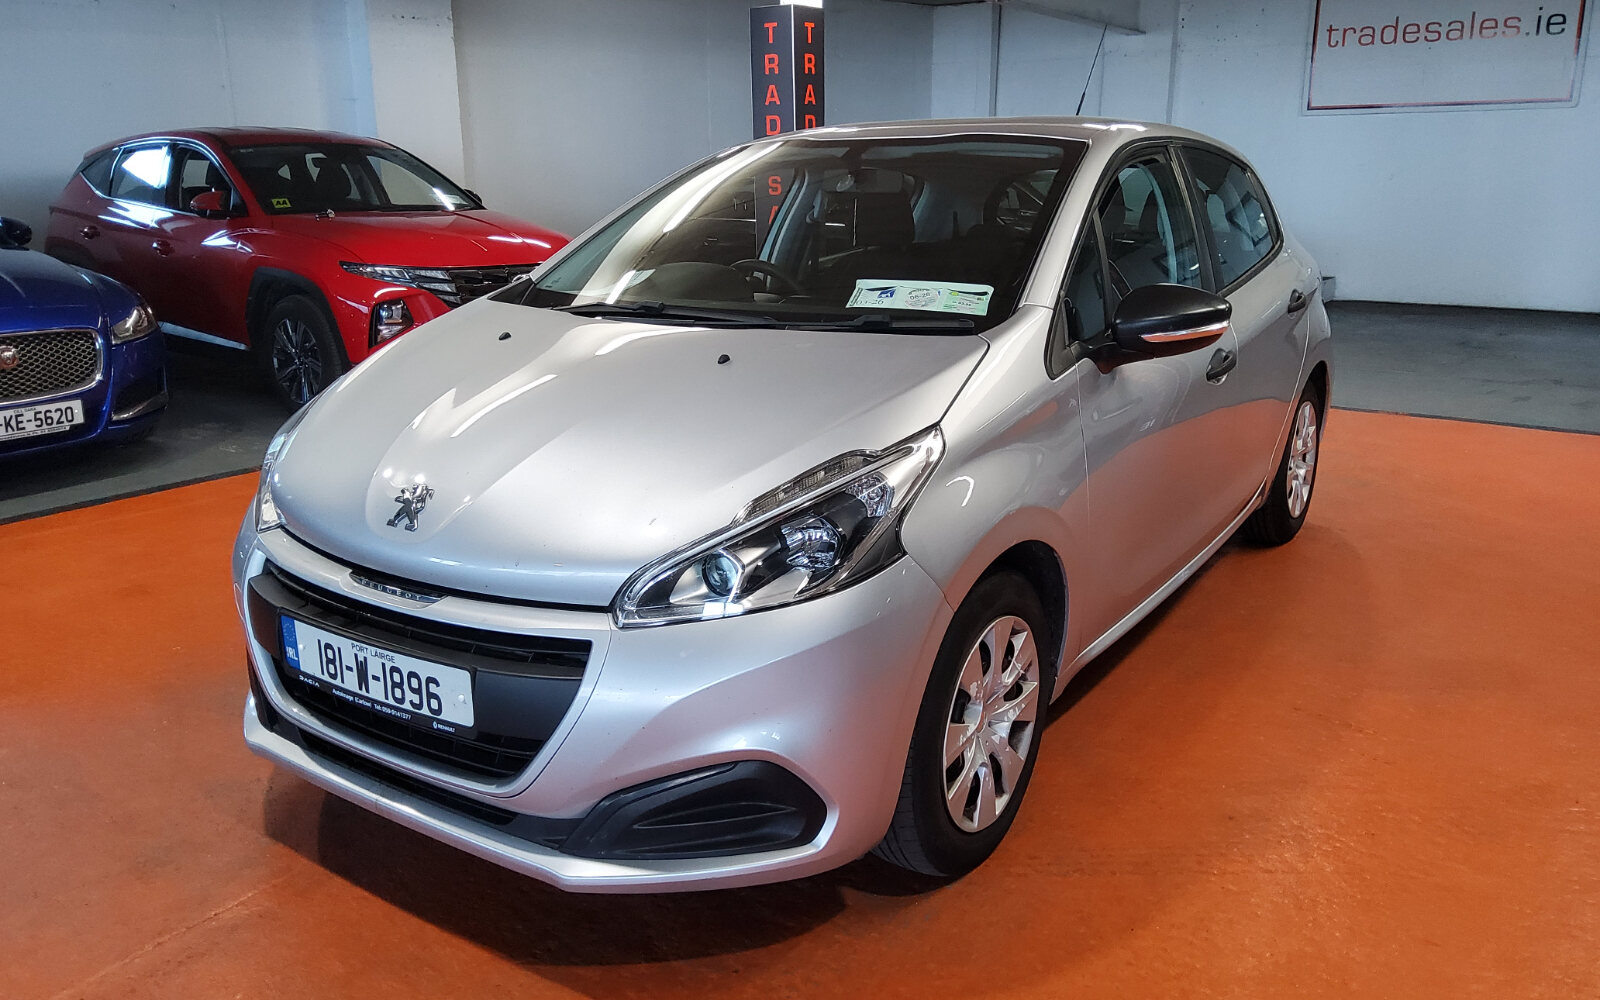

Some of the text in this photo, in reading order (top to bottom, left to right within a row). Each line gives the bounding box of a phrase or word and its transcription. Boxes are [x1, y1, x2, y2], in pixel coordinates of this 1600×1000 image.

[1326, 7, 1567, 48] tradesales.ie
[285, 646, 299, 661] IRL
[351, 642, 369, 655] PORT
[317, 639, 443, 717] 181-W-1896
